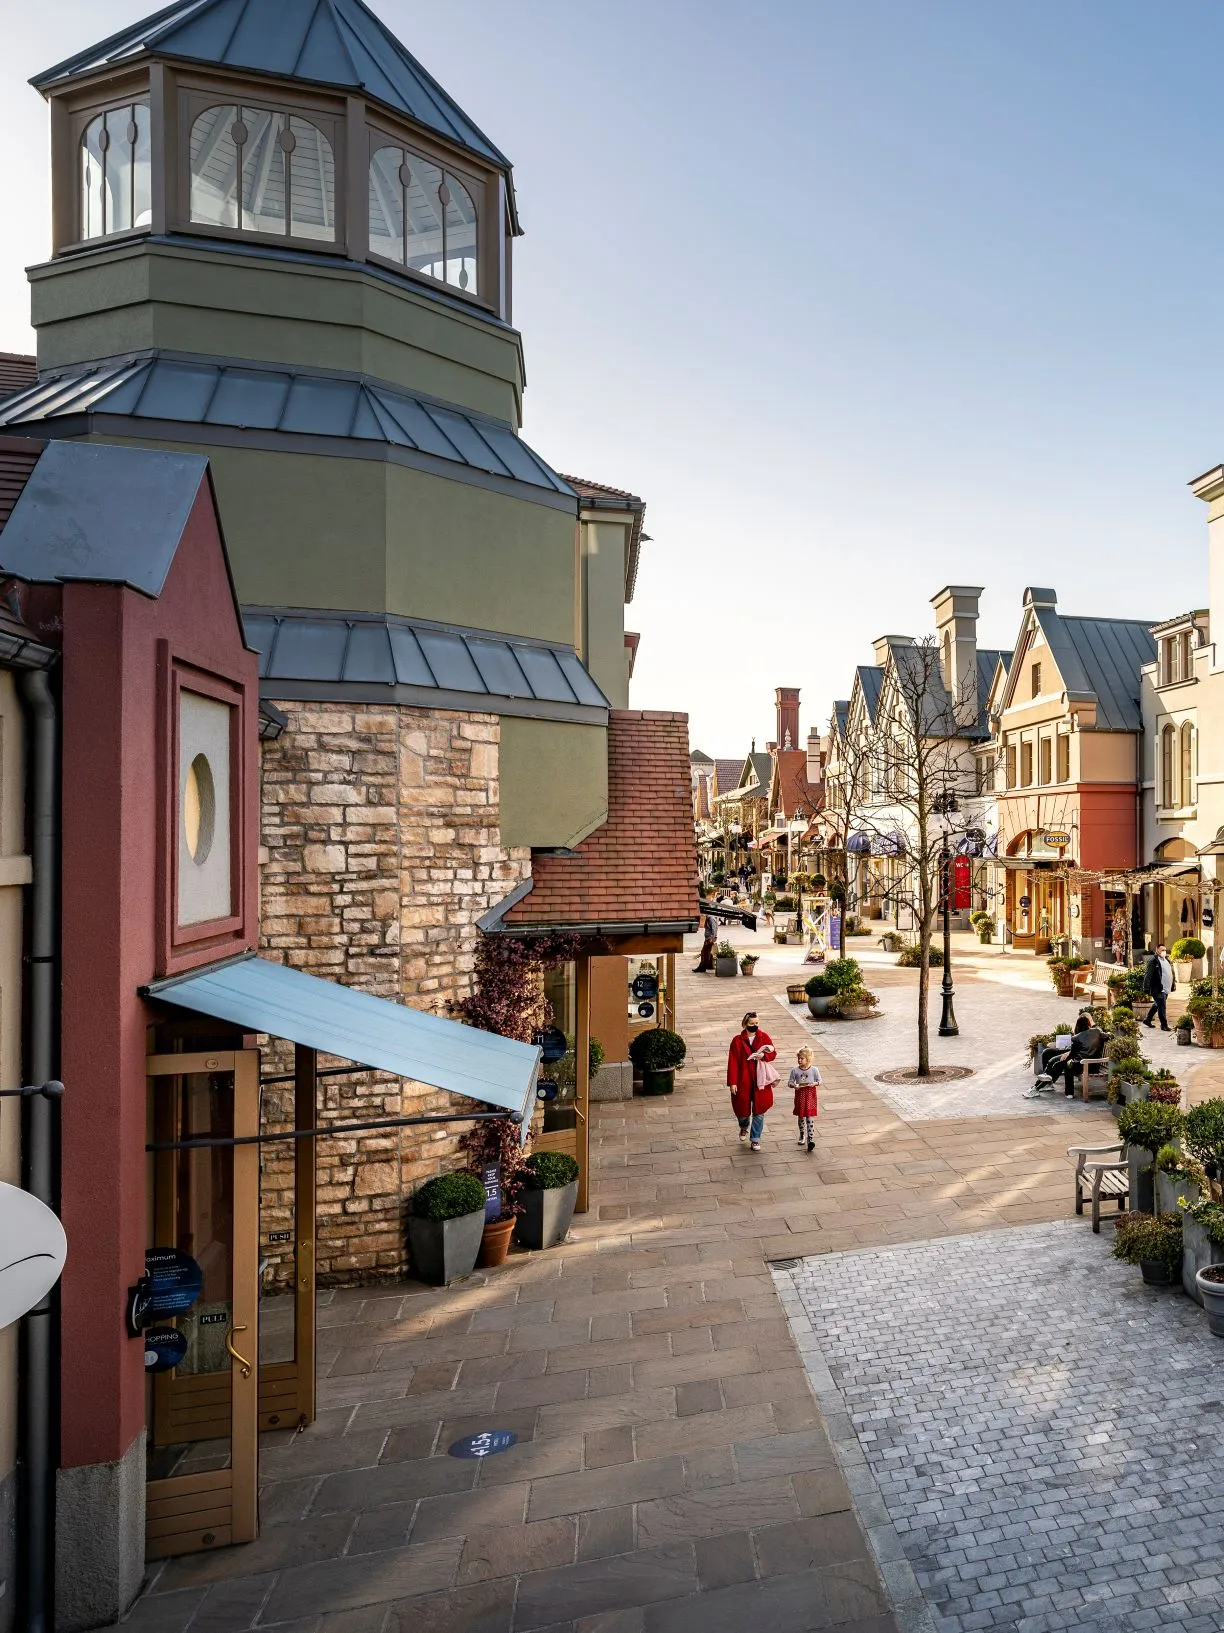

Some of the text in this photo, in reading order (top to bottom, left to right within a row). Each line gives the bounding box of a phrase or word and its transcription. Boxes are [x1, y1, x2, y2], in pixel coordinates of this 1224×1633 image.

[486, 1188, 497, 1197] 1.5
[146, 1254, 177, 1263] aximum
[202, 1314, 226, 1324] PULL
[145, 1333, 179, 1343] HOPPING
